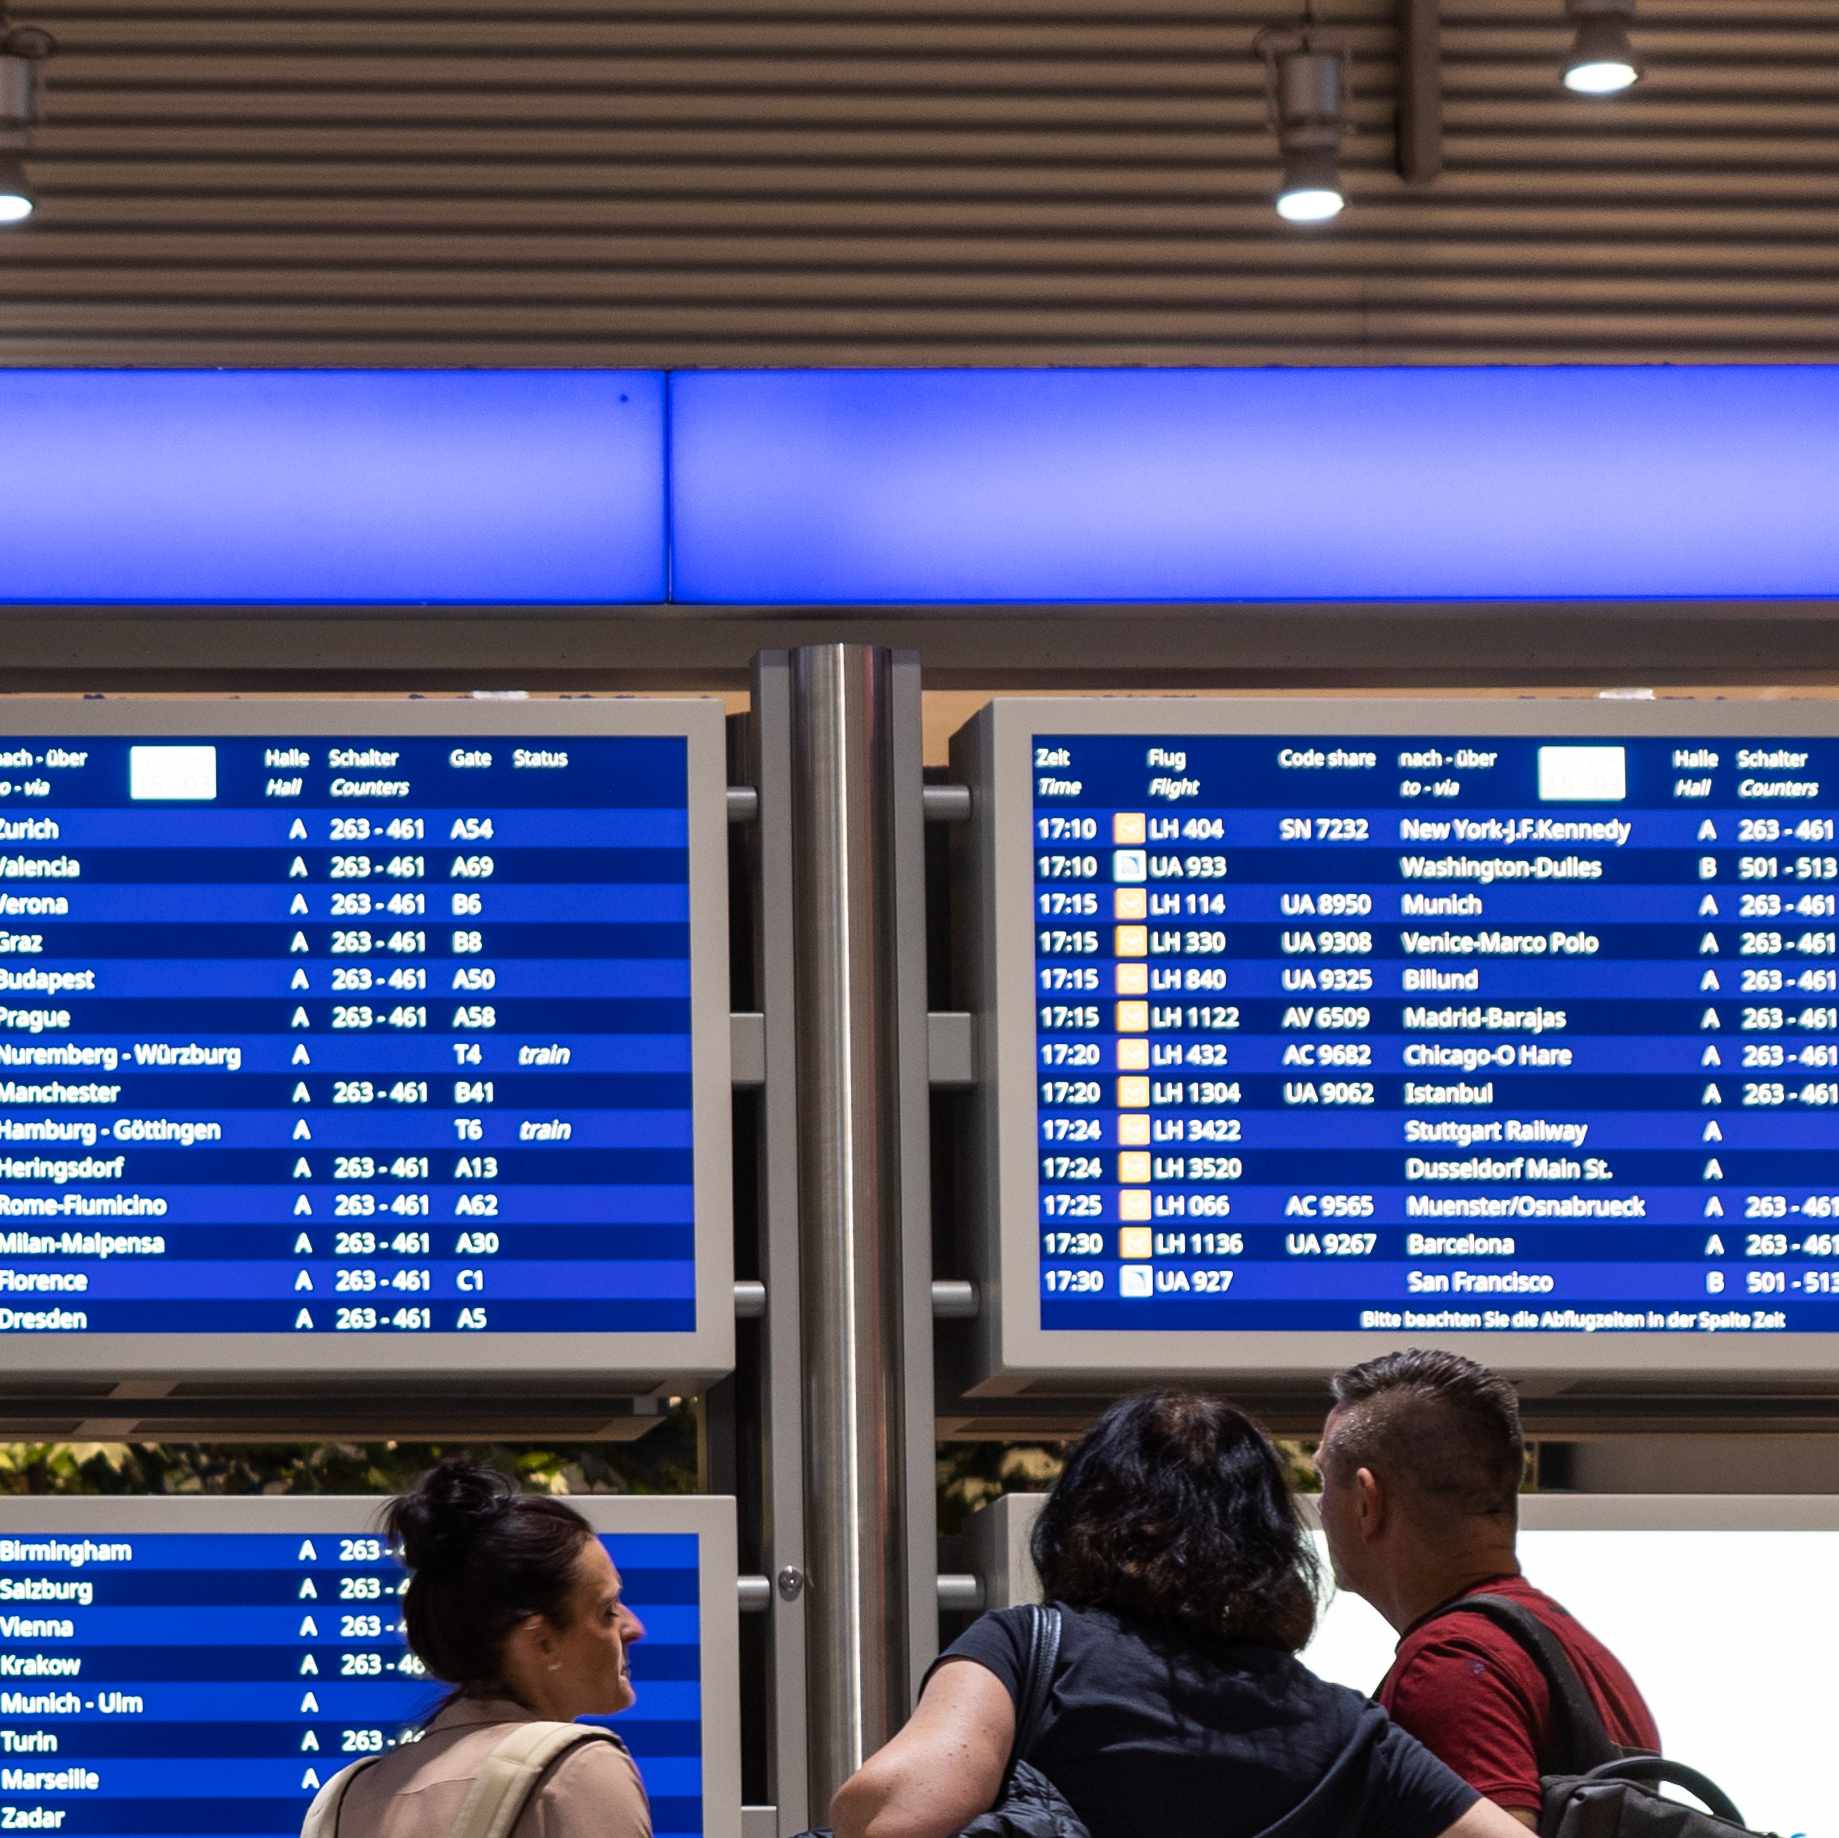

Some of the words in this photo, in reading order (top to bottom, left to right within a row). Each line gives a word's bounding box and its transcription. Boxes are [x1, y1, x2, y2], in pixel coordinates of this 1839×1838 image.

[450, 818, 494, 840] A54
[1038, 817, 1097, 839] 17:10
[1149, 818, 1180, 840] LH
[1182, 818, 1225, 839] 404
[1400, 818, 1451, 840] New
[1452, 818, 1632, 846] York-J.F.Kennedy
[1400, 856, 1603, 883] Washington-Dulles
[1402, 893, 1483, 915] Munich
[1401, 931, 1548, 953] Venice-Marco
[1550, 931, 1600, 953] Polo
[1403, 968, 1479, 990] Billund
[1404, 1006, 1567, 1034] Madrid-Barajas
[1403, 1043, 1516, 1071] Chicago-O
[1519, 1044, 1573, 1066] Hare
[1405, 1082, 1494, 1104] Istanbul
[1404, 1119, 1503, 1147] Stuttgart
[1505, 1119, 1589, 1147] Railway
[1406, 1156, 1525, 1179] Dusseldorf
[1526, 1157, 1581, 1179] Main
[1583, 1158, 1614, 1180] St.
[1406, 1195, 1646, 1217] Muenster/Osnabrueck
[1407, 1233, 1515, 1255] Barcelona
[1407, 1270, 1450, 1292] San
[1452, 1270, 1555, 1293] Francisco
[1361, 1310, 1402, 1328] Bitte
[1403, 1310, 1482, 1328] beachten
[1483, 1310, 1511, 1328] Sie
[1511, 1310, 1540, 1328] die
[1539, 1309, 1646, 1331] Abflugzeiten
[1646, 1310, 1665, 1328] in
[1666, 1310, 1698, 1328] der
[1697, 1311, 1752, 1331] Spalte
[1752, 1311, 1787, 1329] Zeit
[0, 1539, 132, 1567] Birmingham
[0, 1577, 93, 1605] Salzburg
[0, 1653, 81, 1676] Krakow
[0, 1730, 58, 1752] Turin
[1, 1767, 100, 1790] Marseille
[1, 1806, 66, 1829] Zadar
